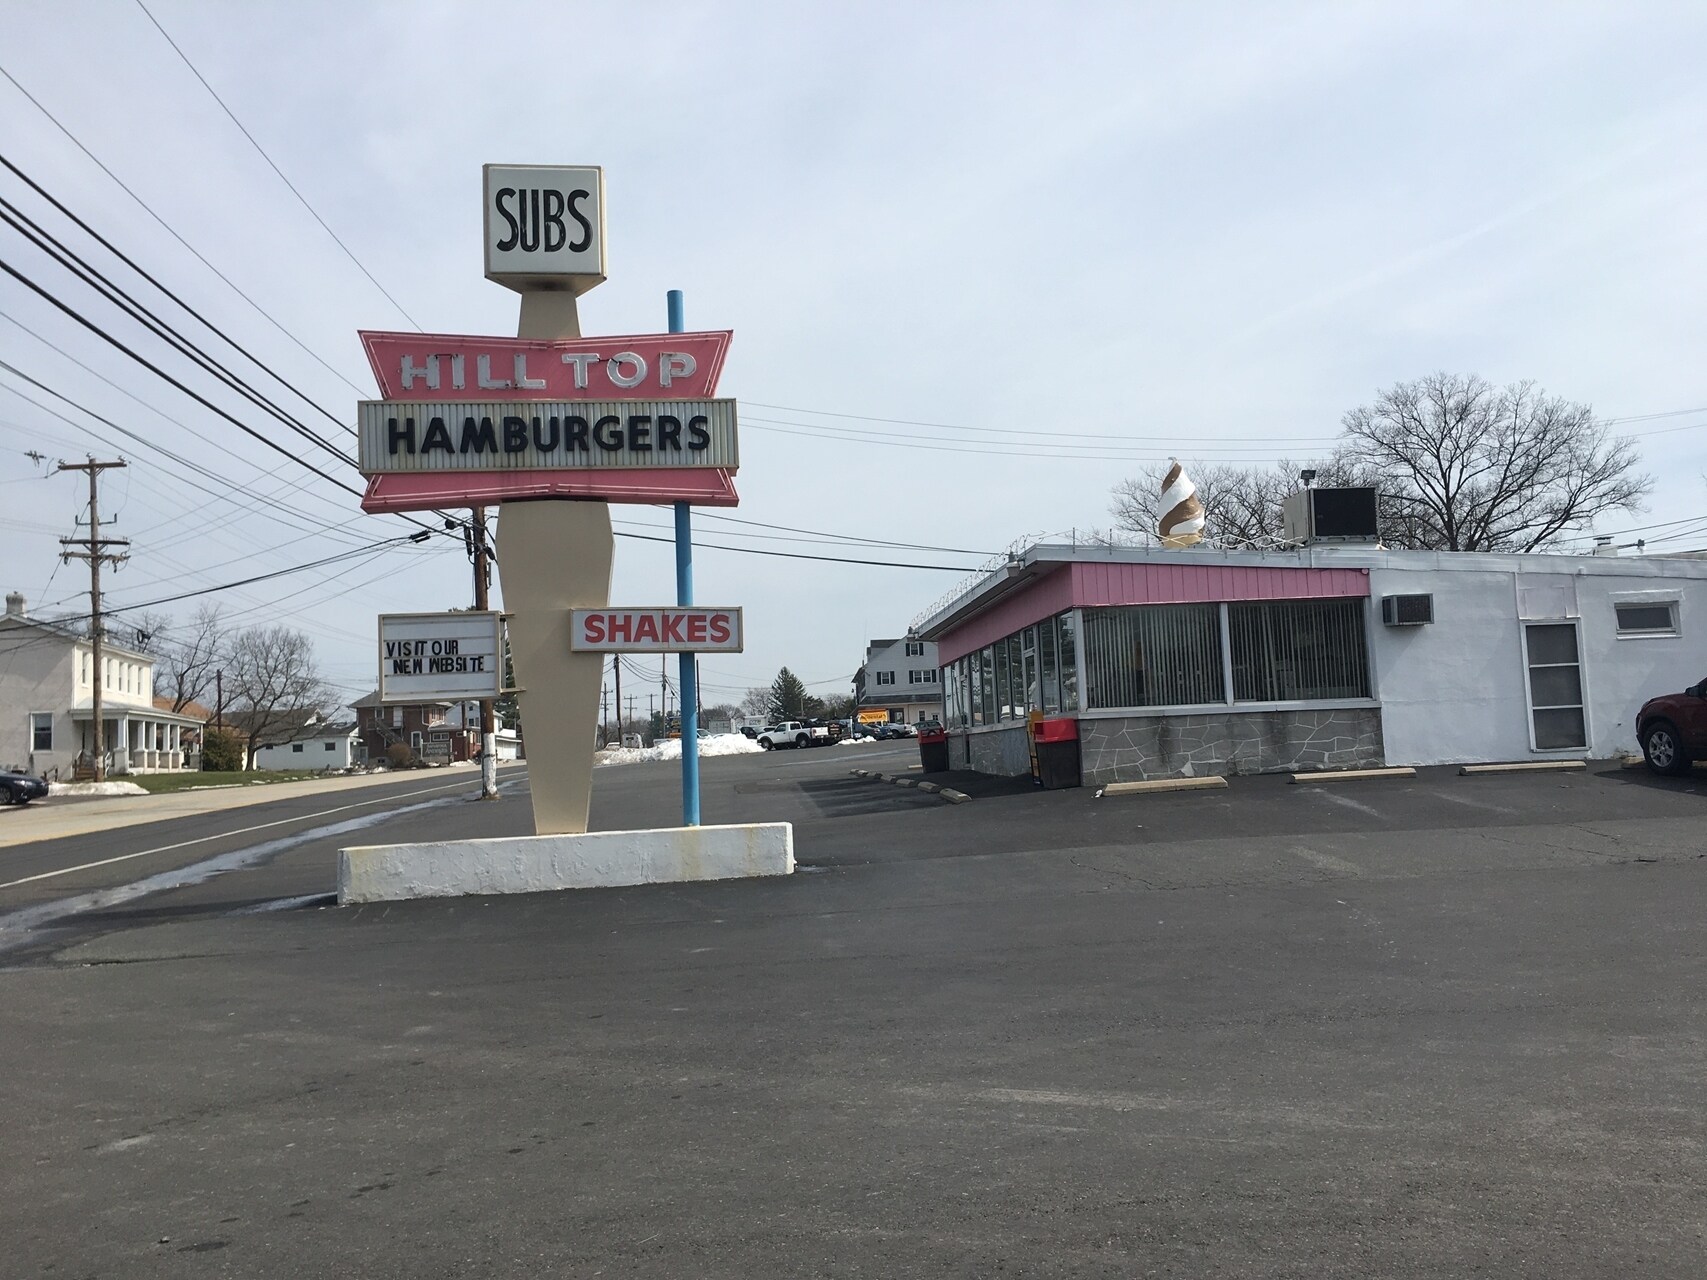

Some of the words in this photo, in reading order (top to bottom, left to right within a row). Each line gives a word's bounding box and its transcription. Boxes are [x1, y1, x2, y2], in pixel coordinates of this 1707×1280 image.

[495, 187, 593, 253] SUBS
[399, 353, 546, 390] HILL
[562, 351, 697, 389] TOP
[388, 415, 711, 455] HAMBURGERS
[584, 614, 731, 643] SHAKES
[386, 640, 427, 657] VISIT
[431, 640, 459, 656] OUR
[393, 659, 423, 674] NEW
[429, 656, 484, 673] WEBSITE
